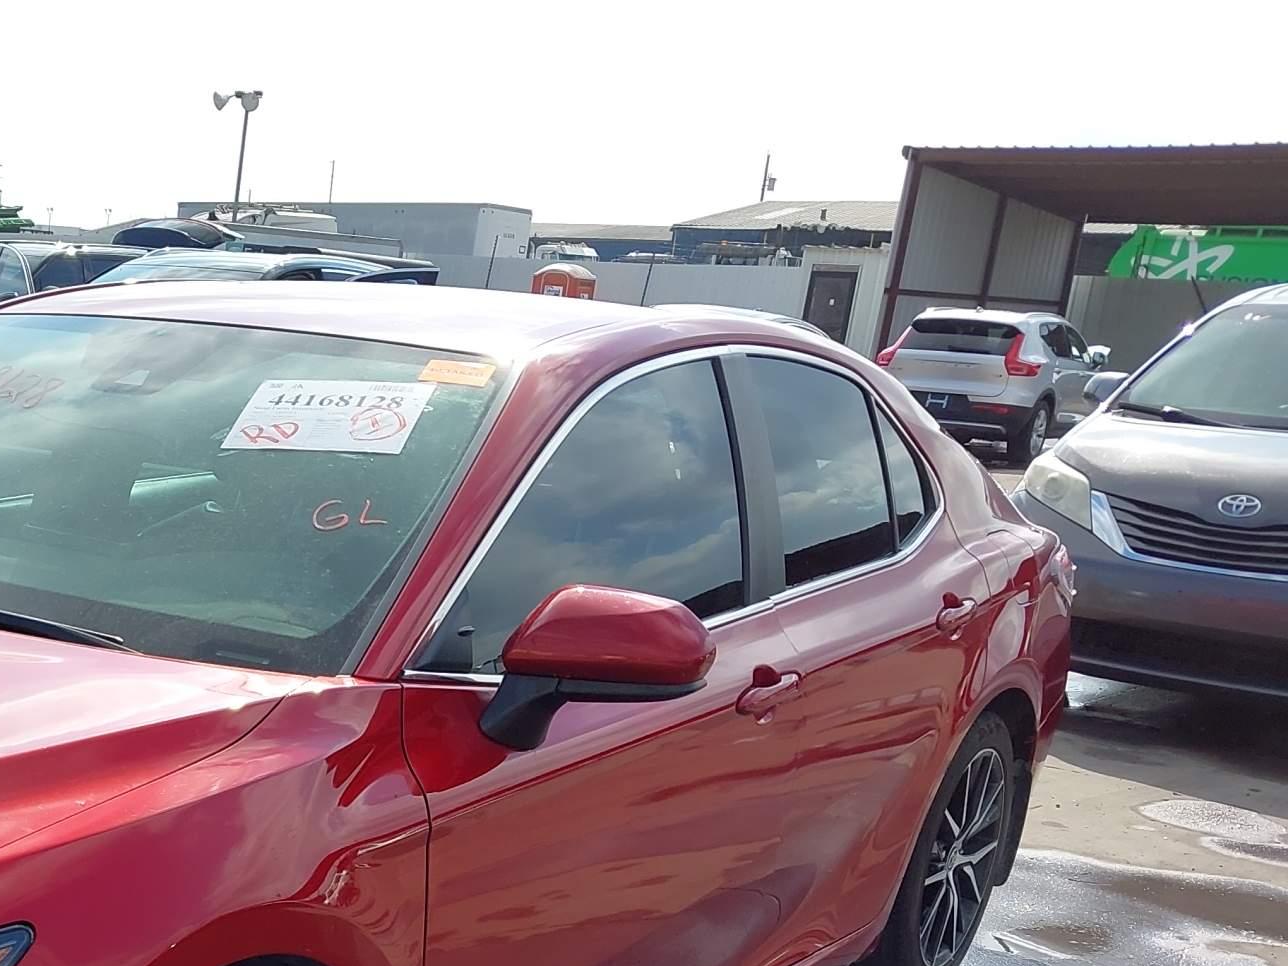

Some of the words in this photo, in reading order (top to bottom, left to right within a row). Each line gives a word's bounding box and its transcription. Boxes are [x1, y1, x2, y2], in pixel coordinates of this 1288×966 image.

[268, 393, 404, 410] 44168128
[240, 421, 300, 444] RD
[312, 499, 388, 531] GL
